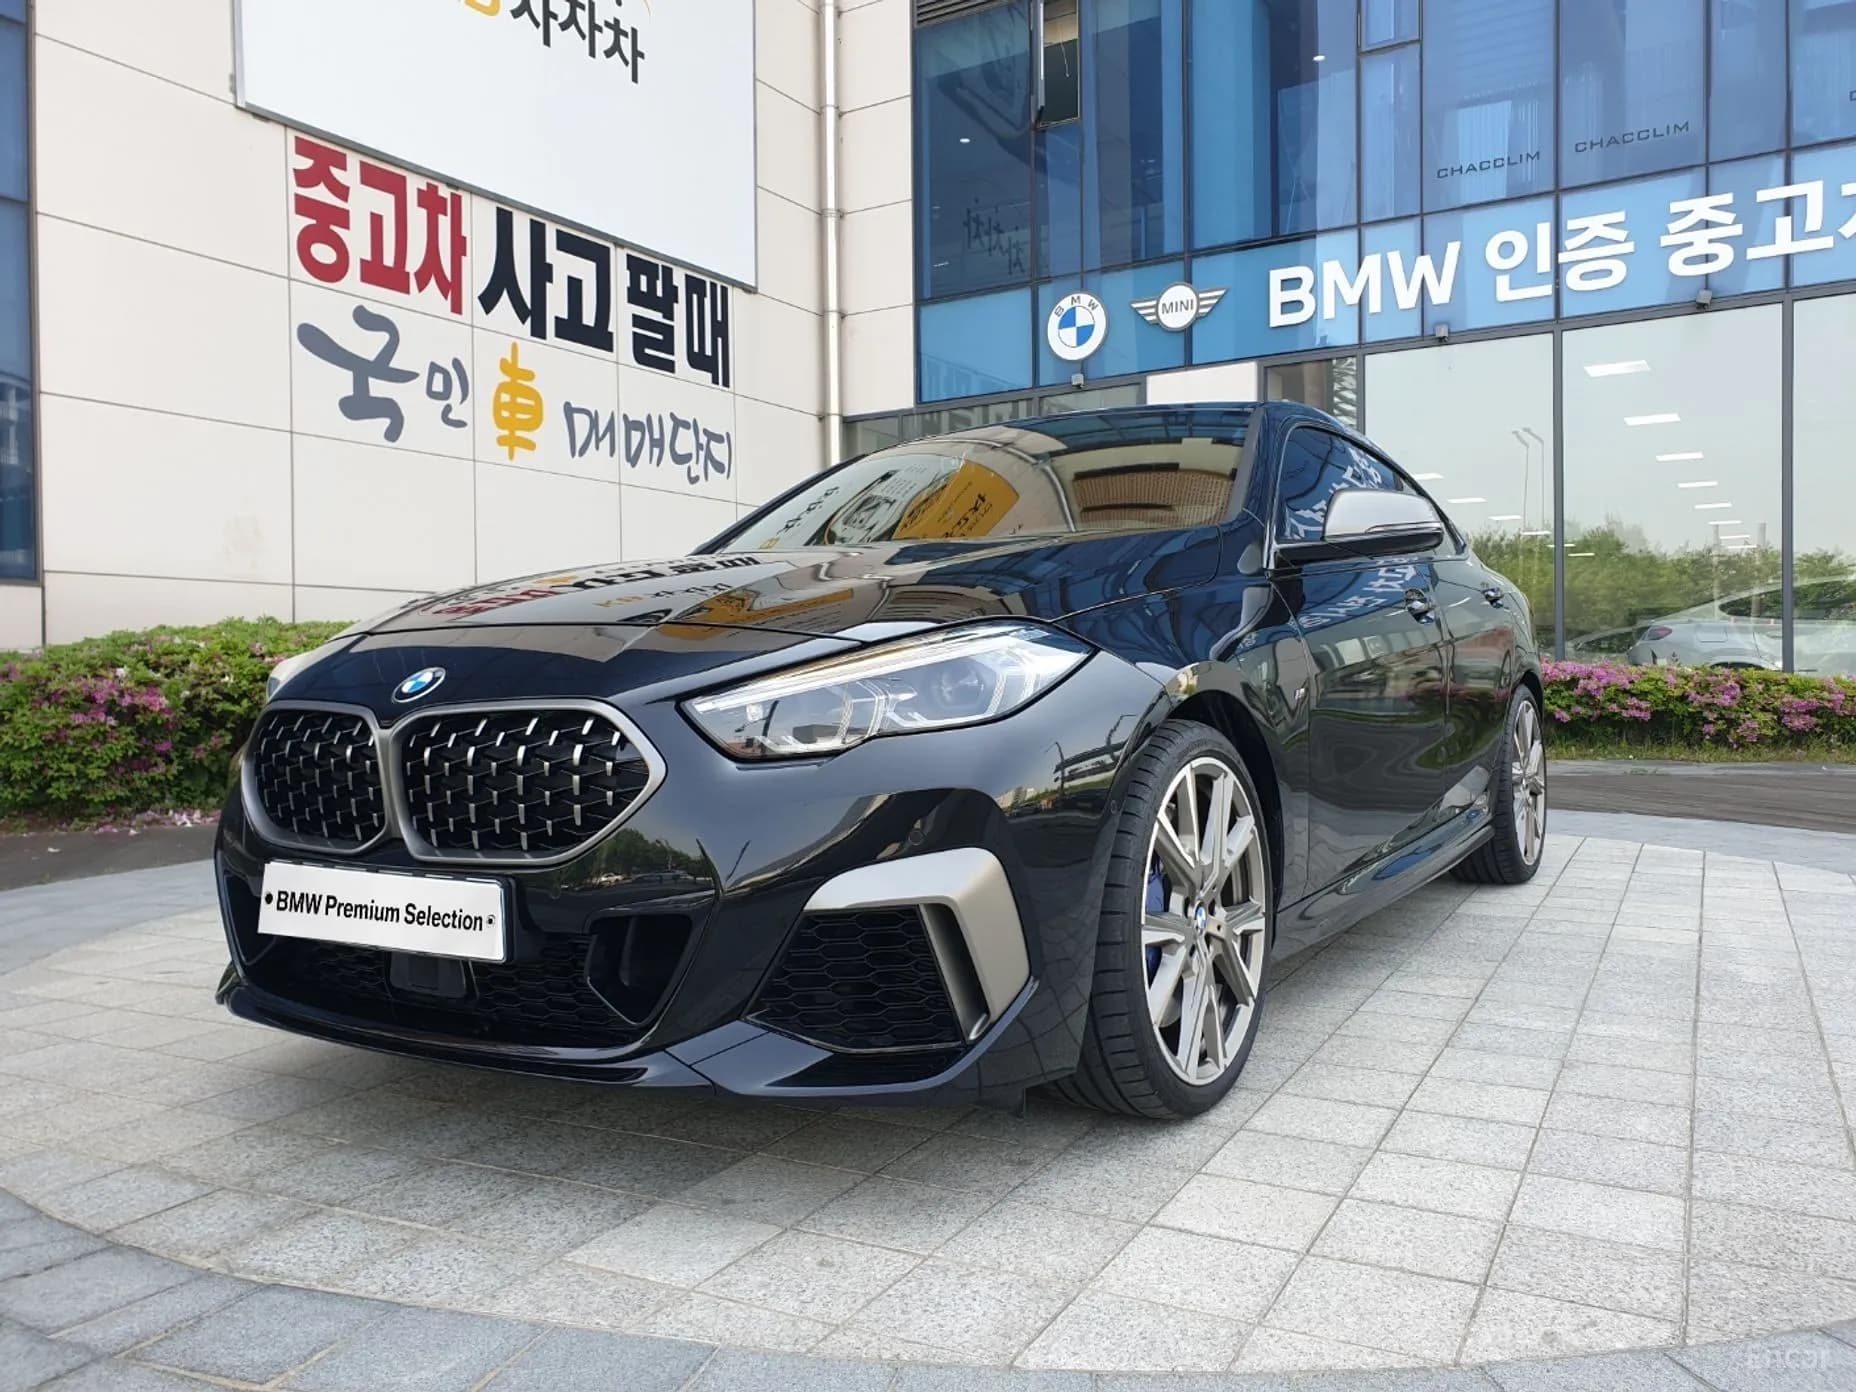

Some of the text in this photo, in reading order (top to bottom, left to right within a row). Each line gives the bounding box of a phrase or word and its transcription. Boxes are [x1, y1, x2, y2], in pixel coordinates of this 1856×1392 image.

[293, 135, 467, 316] 중고차
[1269, 240, 1461, 328] BMW
[1485, 211, 1635, 302] 인증
[1054, 295, 1098, 317] BMW
[1161, 298, 1195, 315] MINI
[276, 890, 483, 931] BMW Premium Selection
